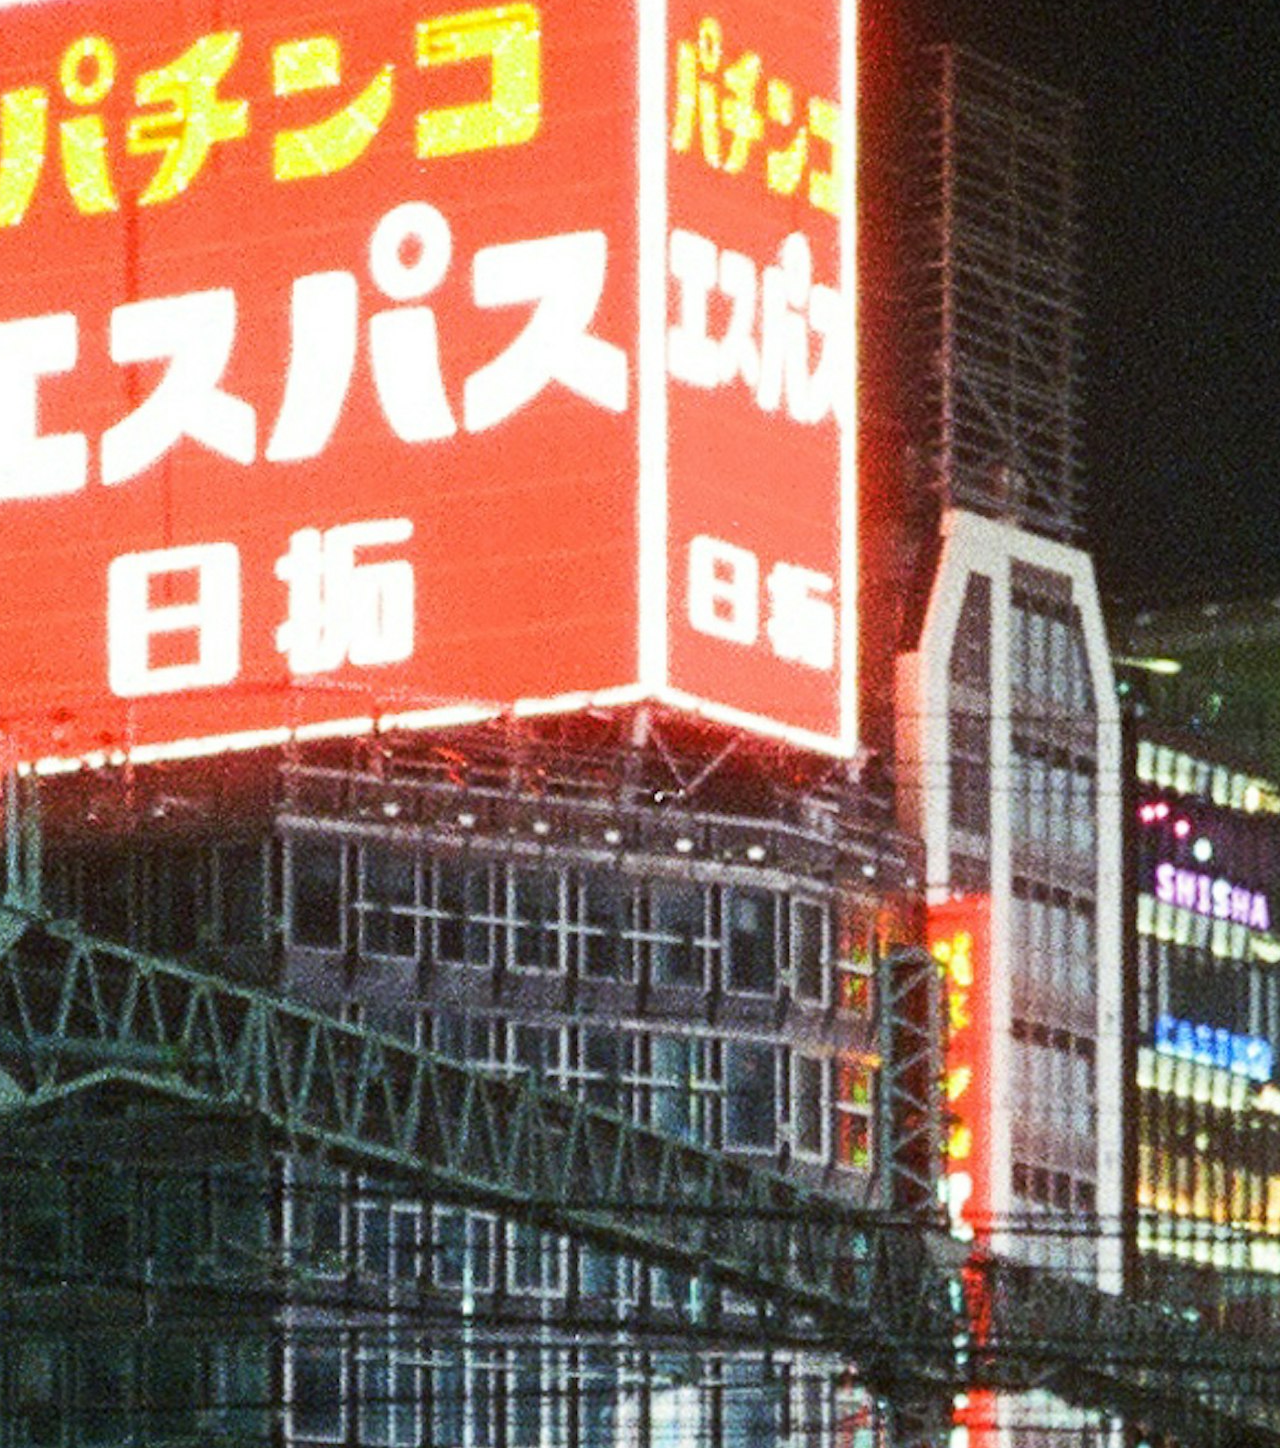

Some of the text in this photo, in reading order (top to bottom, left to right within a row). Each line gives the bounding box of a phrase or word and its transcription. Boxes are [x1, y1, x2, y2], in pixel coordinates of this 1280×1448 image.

[672, 15, 844, 216] パチンコ
[668, 227, 844, 424] エスパス
[107, 517, 416, 698] 日拓
[1156, 862, 1270, 931] SHISHA
